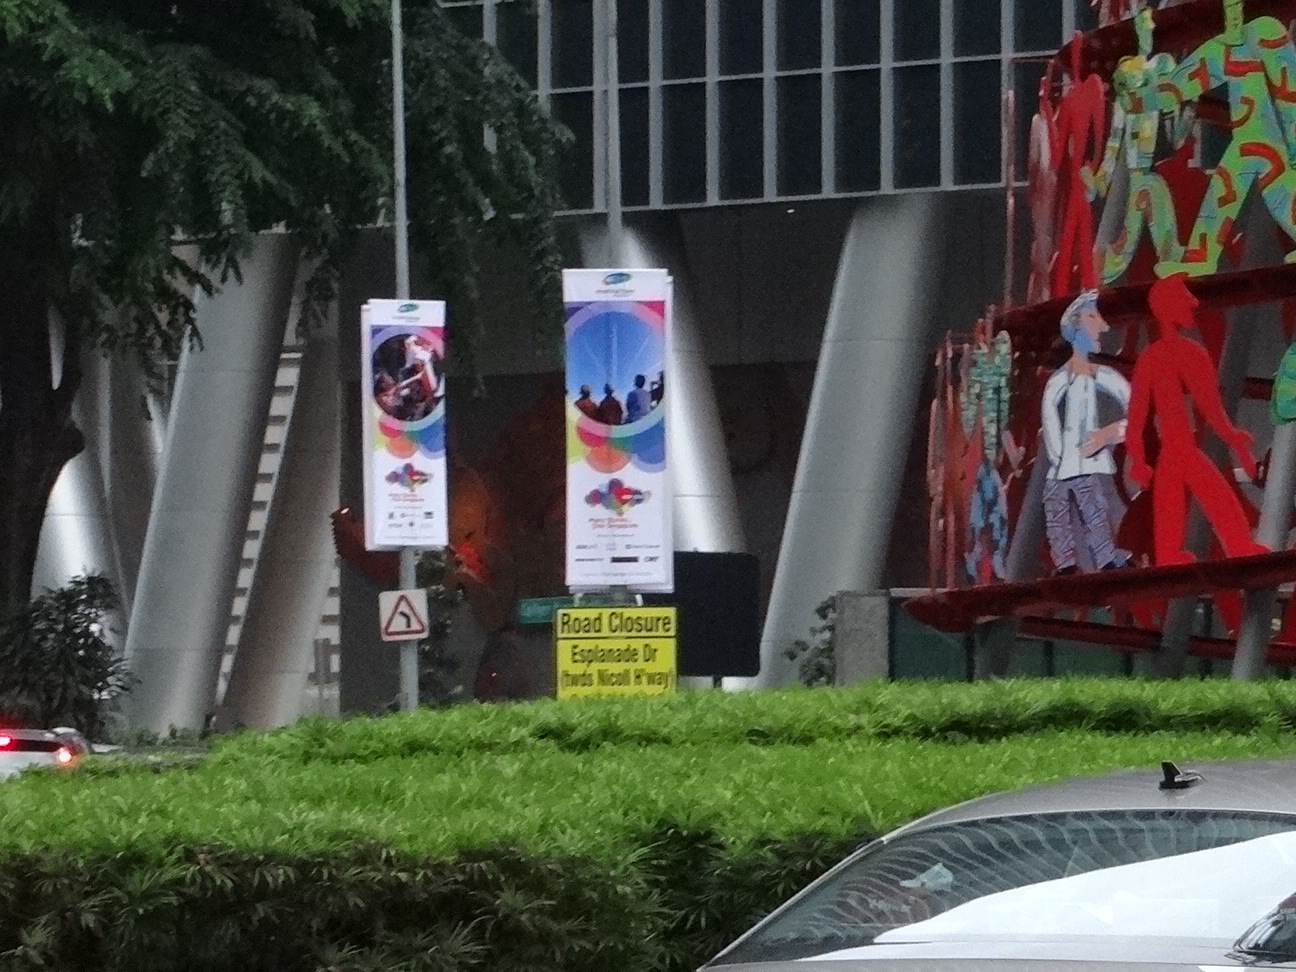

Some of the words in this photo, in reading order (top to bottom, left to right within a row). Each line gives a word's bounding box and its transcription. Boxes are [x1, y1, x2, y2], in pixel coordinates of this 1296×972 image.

[561, 612, 602, 633] Road
[609, 611, 672, 633] Closure
[571, 644, 639, 668] Esplanade
[643, 643, 659, 662] Dr
